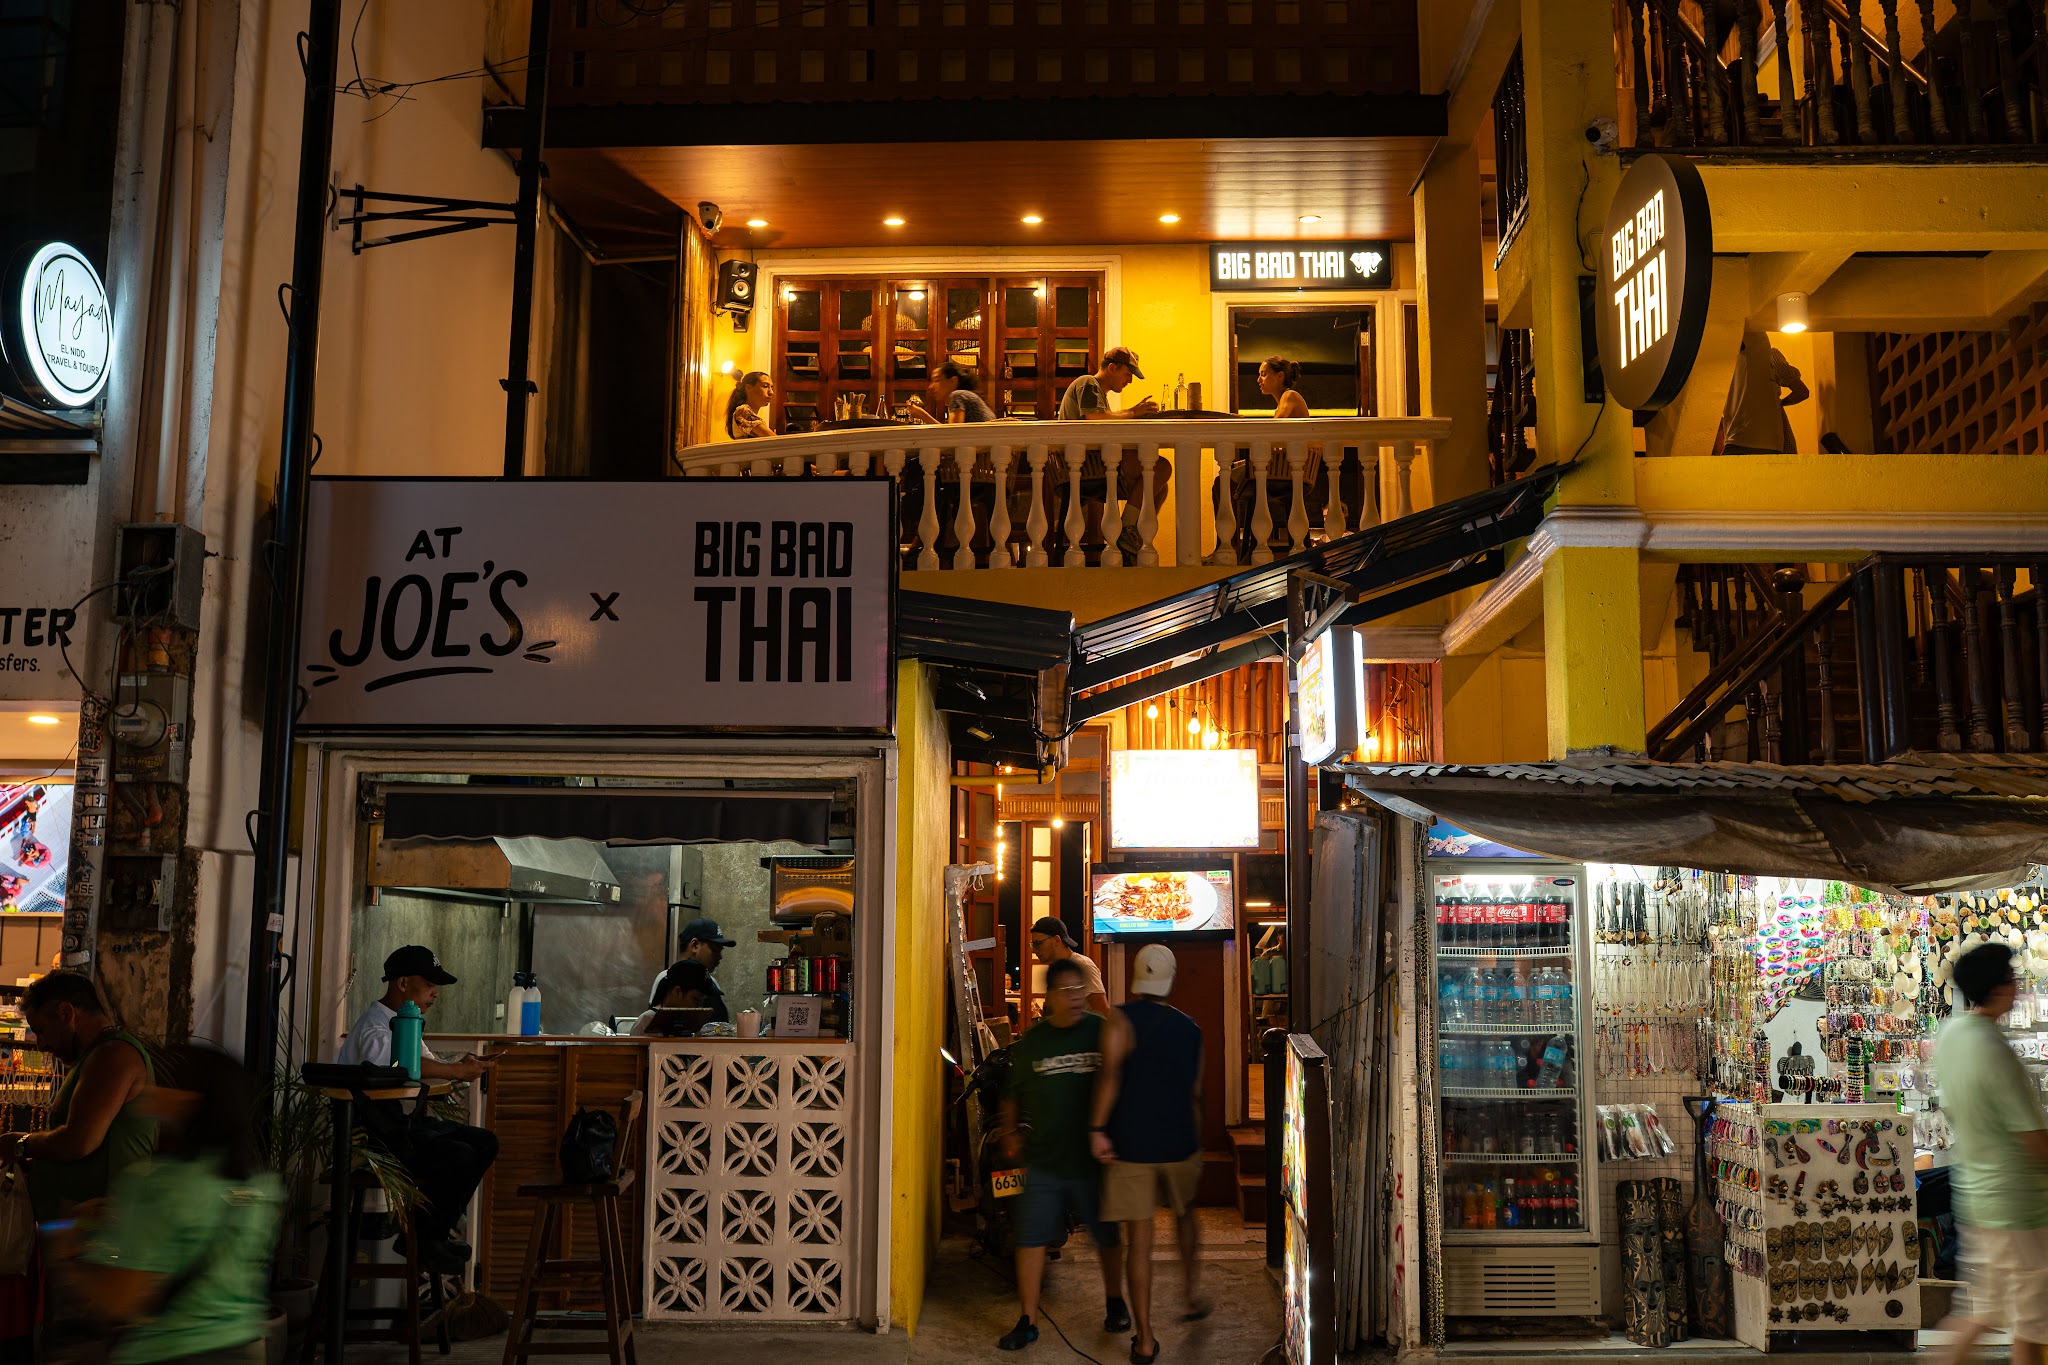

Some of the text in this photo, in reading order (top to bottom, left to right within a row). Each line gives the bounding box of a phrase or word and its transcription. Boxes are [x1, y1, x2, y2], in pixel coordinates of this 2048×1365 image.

[1612, 188, 1665, 283] BIG BAD
[1217, 251, 1345, 279] BIG BAD THAI
[1614, 248, 1668, 370] THAI
[46, 353, 100, 376] TRAVEL & TOURS
[60, 344, 86, 359] EL NIDO
[404, 526, 463, 562] AT
[694, 521, 853, 578] BIG BAD
[0, 607, 77, 648] TER
[328, 560, 528, 667] JOE'S
[694, 586, 852, 682] THAI
[81, 815, 107, 829] NEAT
